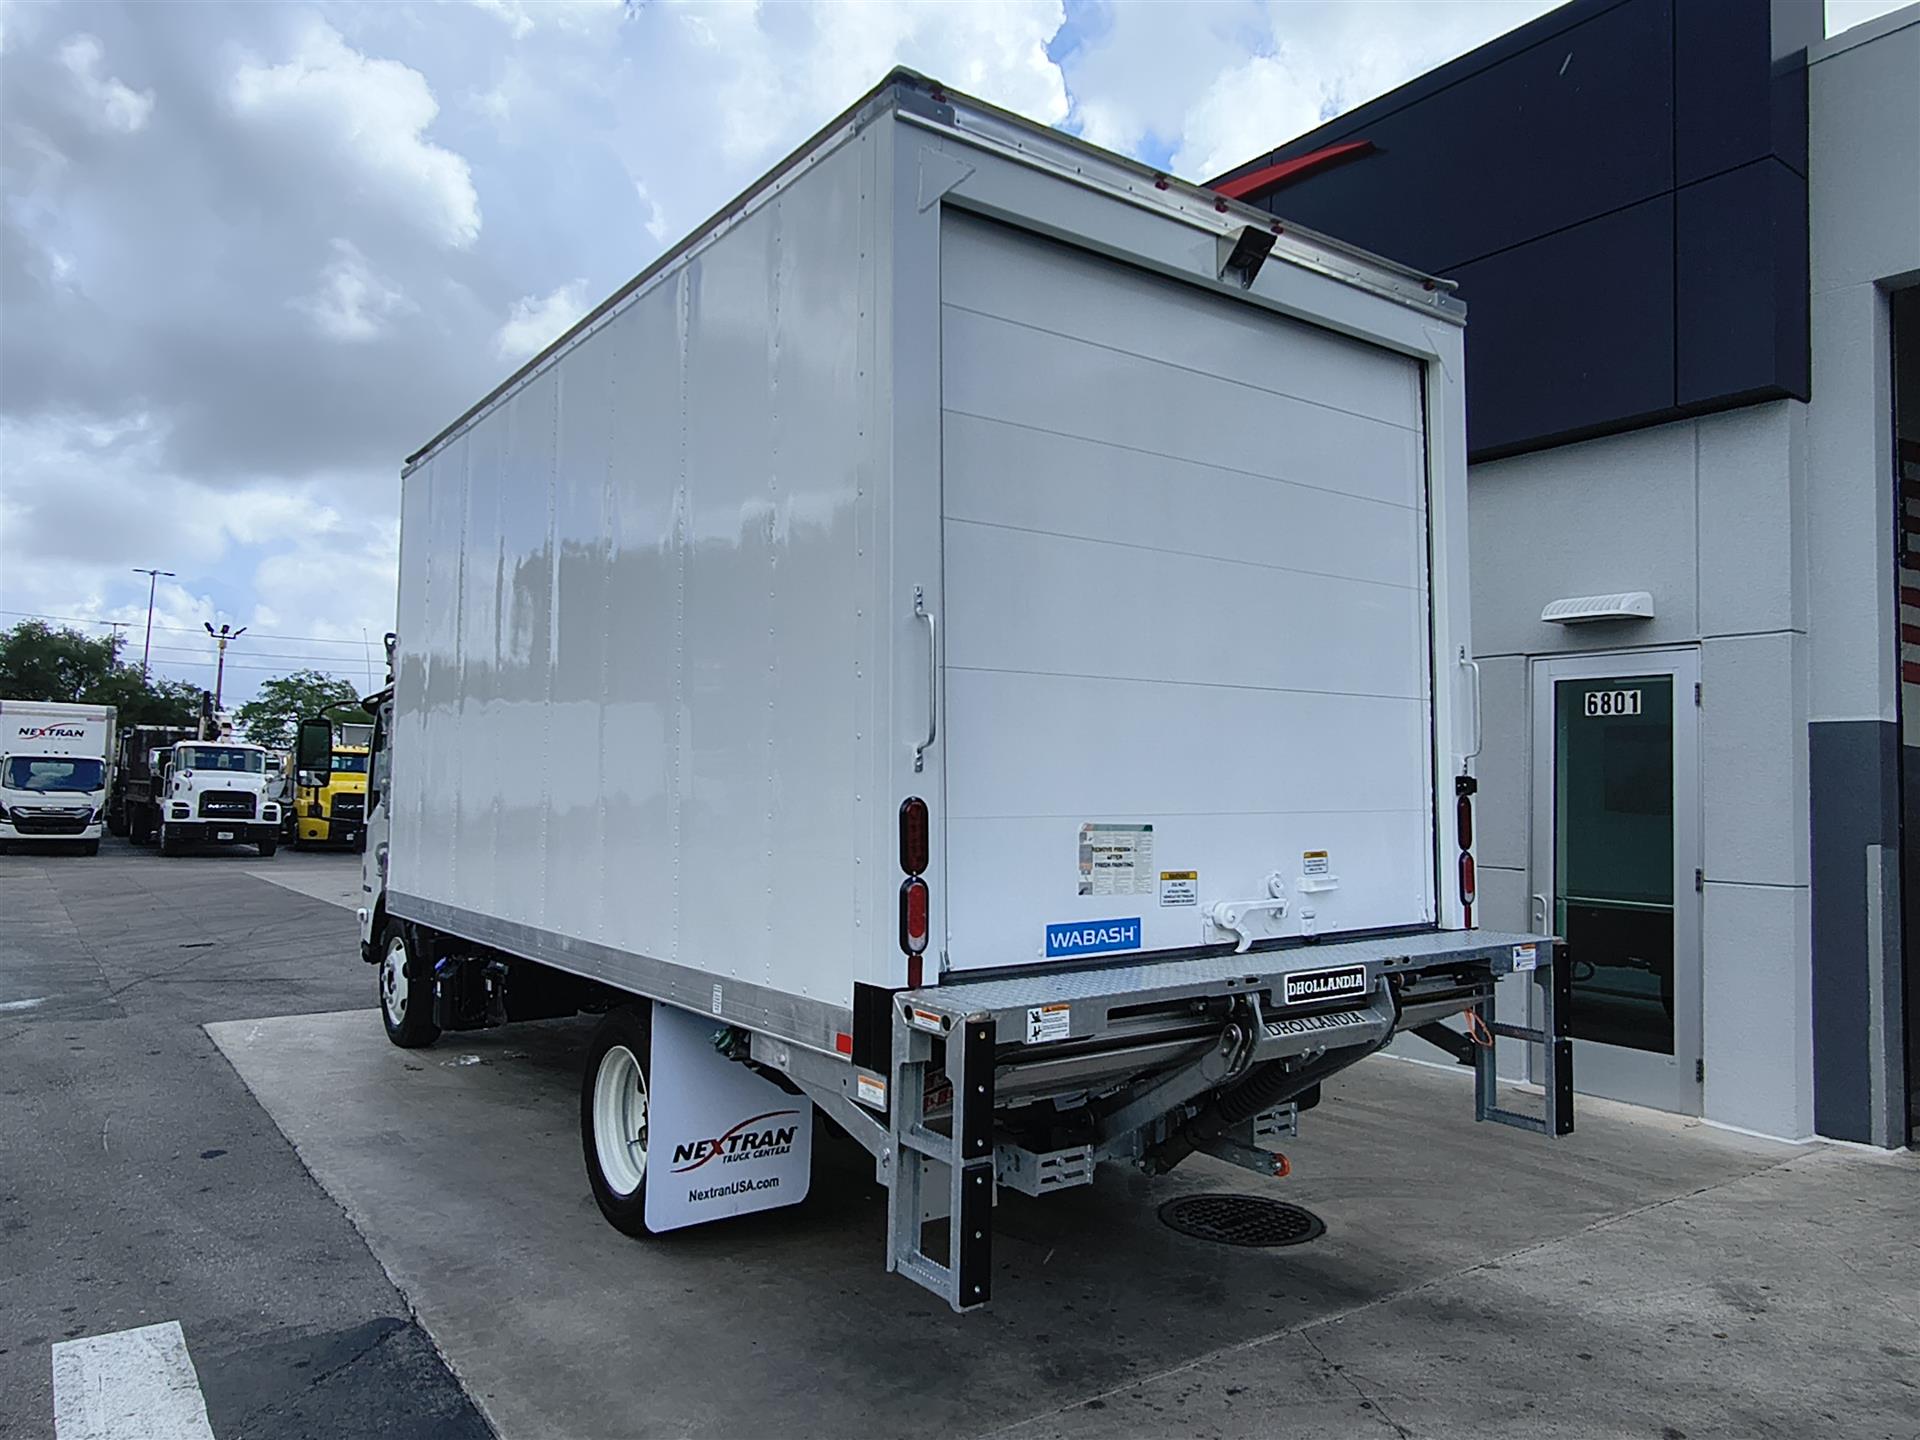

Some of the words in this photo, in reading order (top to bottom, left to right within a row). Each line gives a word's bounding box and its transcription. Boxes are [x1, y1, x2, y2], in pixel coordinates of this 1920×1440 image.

[1588, 692, 1638, 714] 6801
[19, 727, 84, 738] NEXTRAN
[1050, 926, 1134, 948] WABASH
[1288, 974, 1363, 996] DHOLLANDIA
[1264, 1011, 1366, 1037] DHOLLANDIA
[672, 1127, 795, 1163] NEXTRAN
[722, 1152, 750, 1164] TRUCK
[753, 1145, 791, 1159] CENTERS
[689, 1177, 779, 1202] NextranUSA.com
